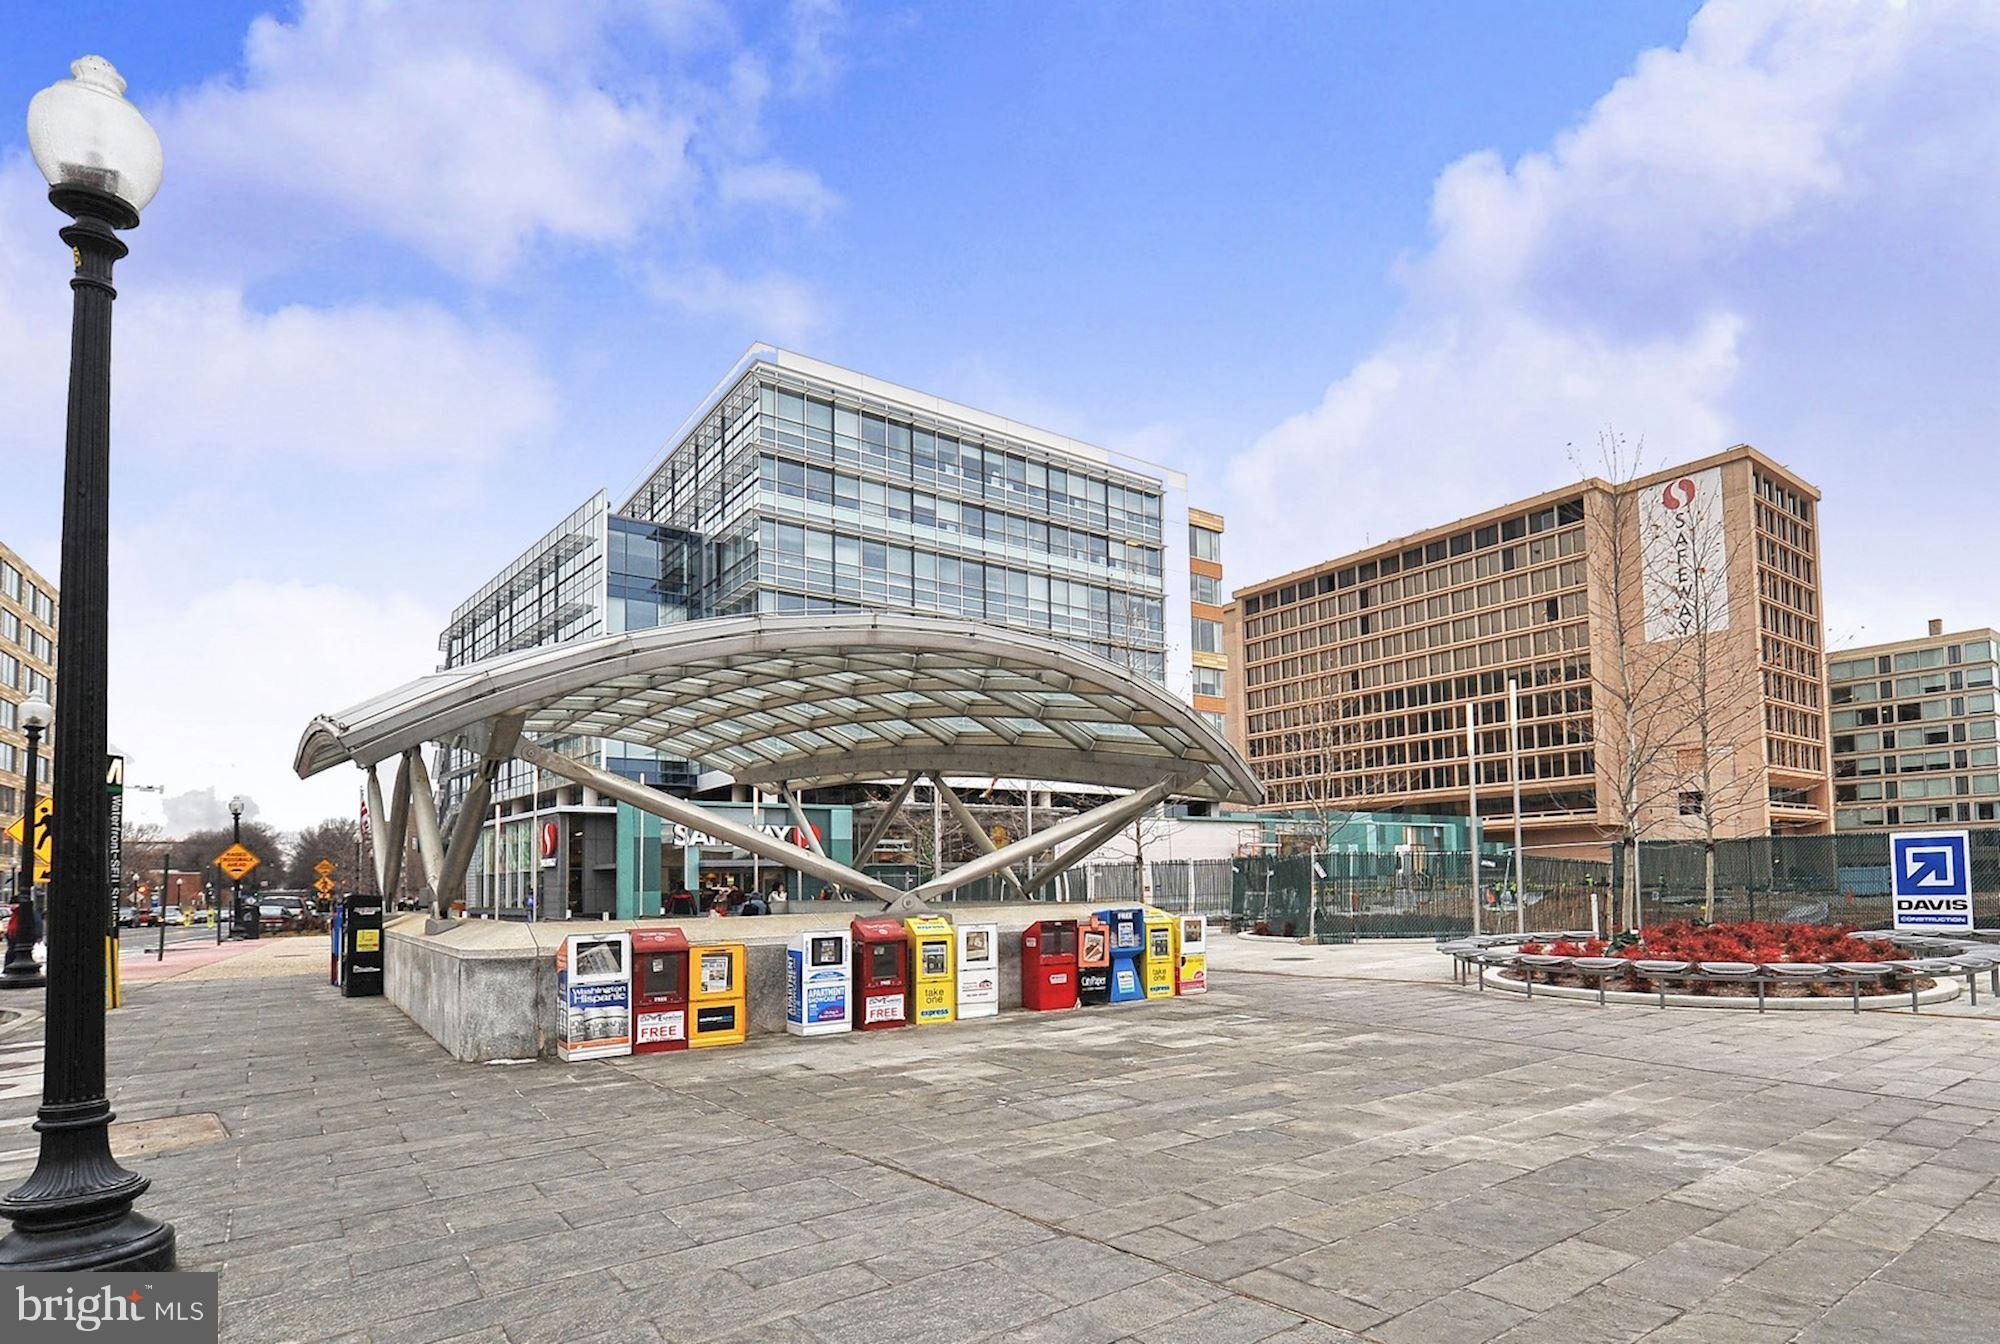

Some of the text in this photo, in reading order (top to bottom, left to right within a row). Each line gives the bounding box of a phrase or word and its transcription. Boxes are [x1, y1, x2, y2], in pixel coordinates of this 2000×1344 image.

[1674, 512, 1693, 636] SAFEWAY
[673, 824, 793, 846] SAAY
[1897, 900, 1968, 911] DAVIS
[1117, 912, 1133, 920] FREE
[1900, 915, 1967, 923] CONSTRUCTION
[572, 986, 626, 996] Washington
[925, 989, 944, 997] take
[573, 992, 626, 1004] Hispanic
[870, 1007, 898, 1018] FREE
[921, 1008, 949, 1018] express
[641, 1025, 677, 1038] FREE
